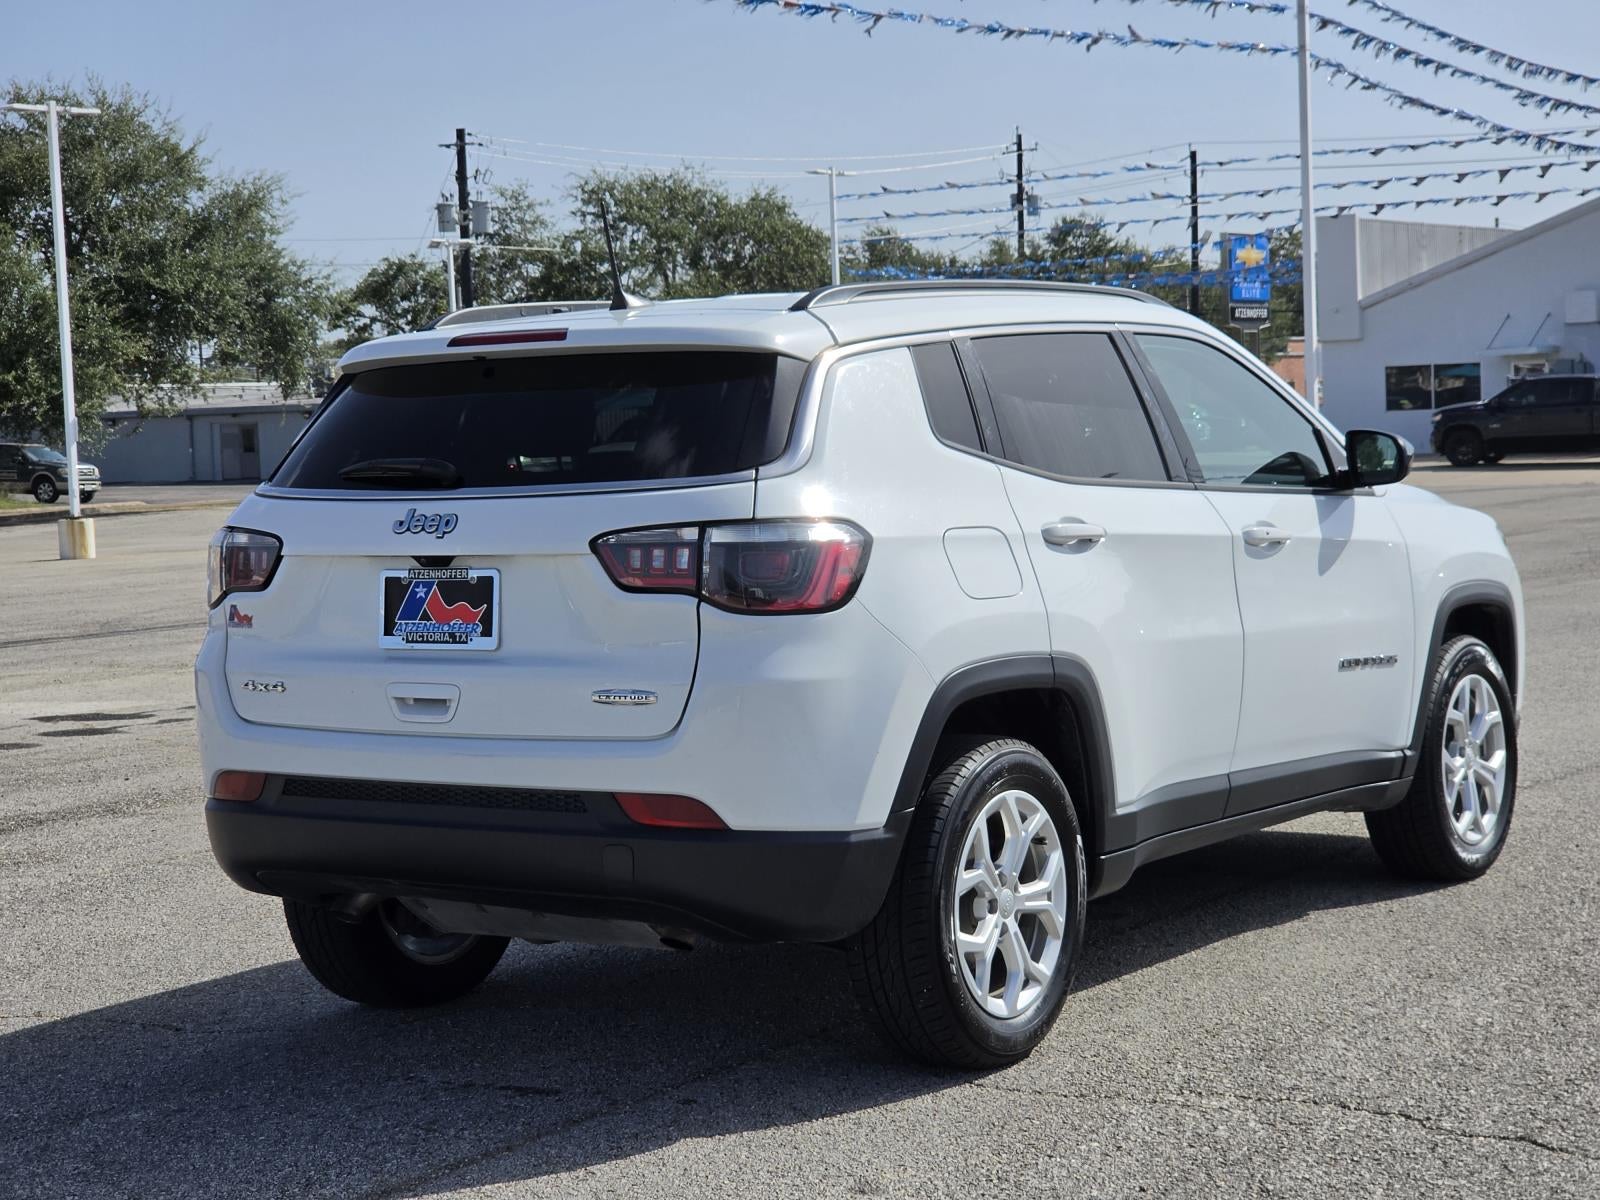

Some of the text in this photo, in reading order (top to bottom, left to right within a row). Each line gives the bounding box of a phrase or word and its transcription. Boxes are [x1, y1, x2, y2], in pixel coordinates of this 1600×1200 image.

[1234, 307, 1268, 319] ATZENHOFFER
[392, 508, 459, 539] Jeep
[408, 569, 468, 579] ATZENHOFFER
[407, 632, 467, 643] VICTORIA, TX
[241, 680, 287, 693] 4x4
